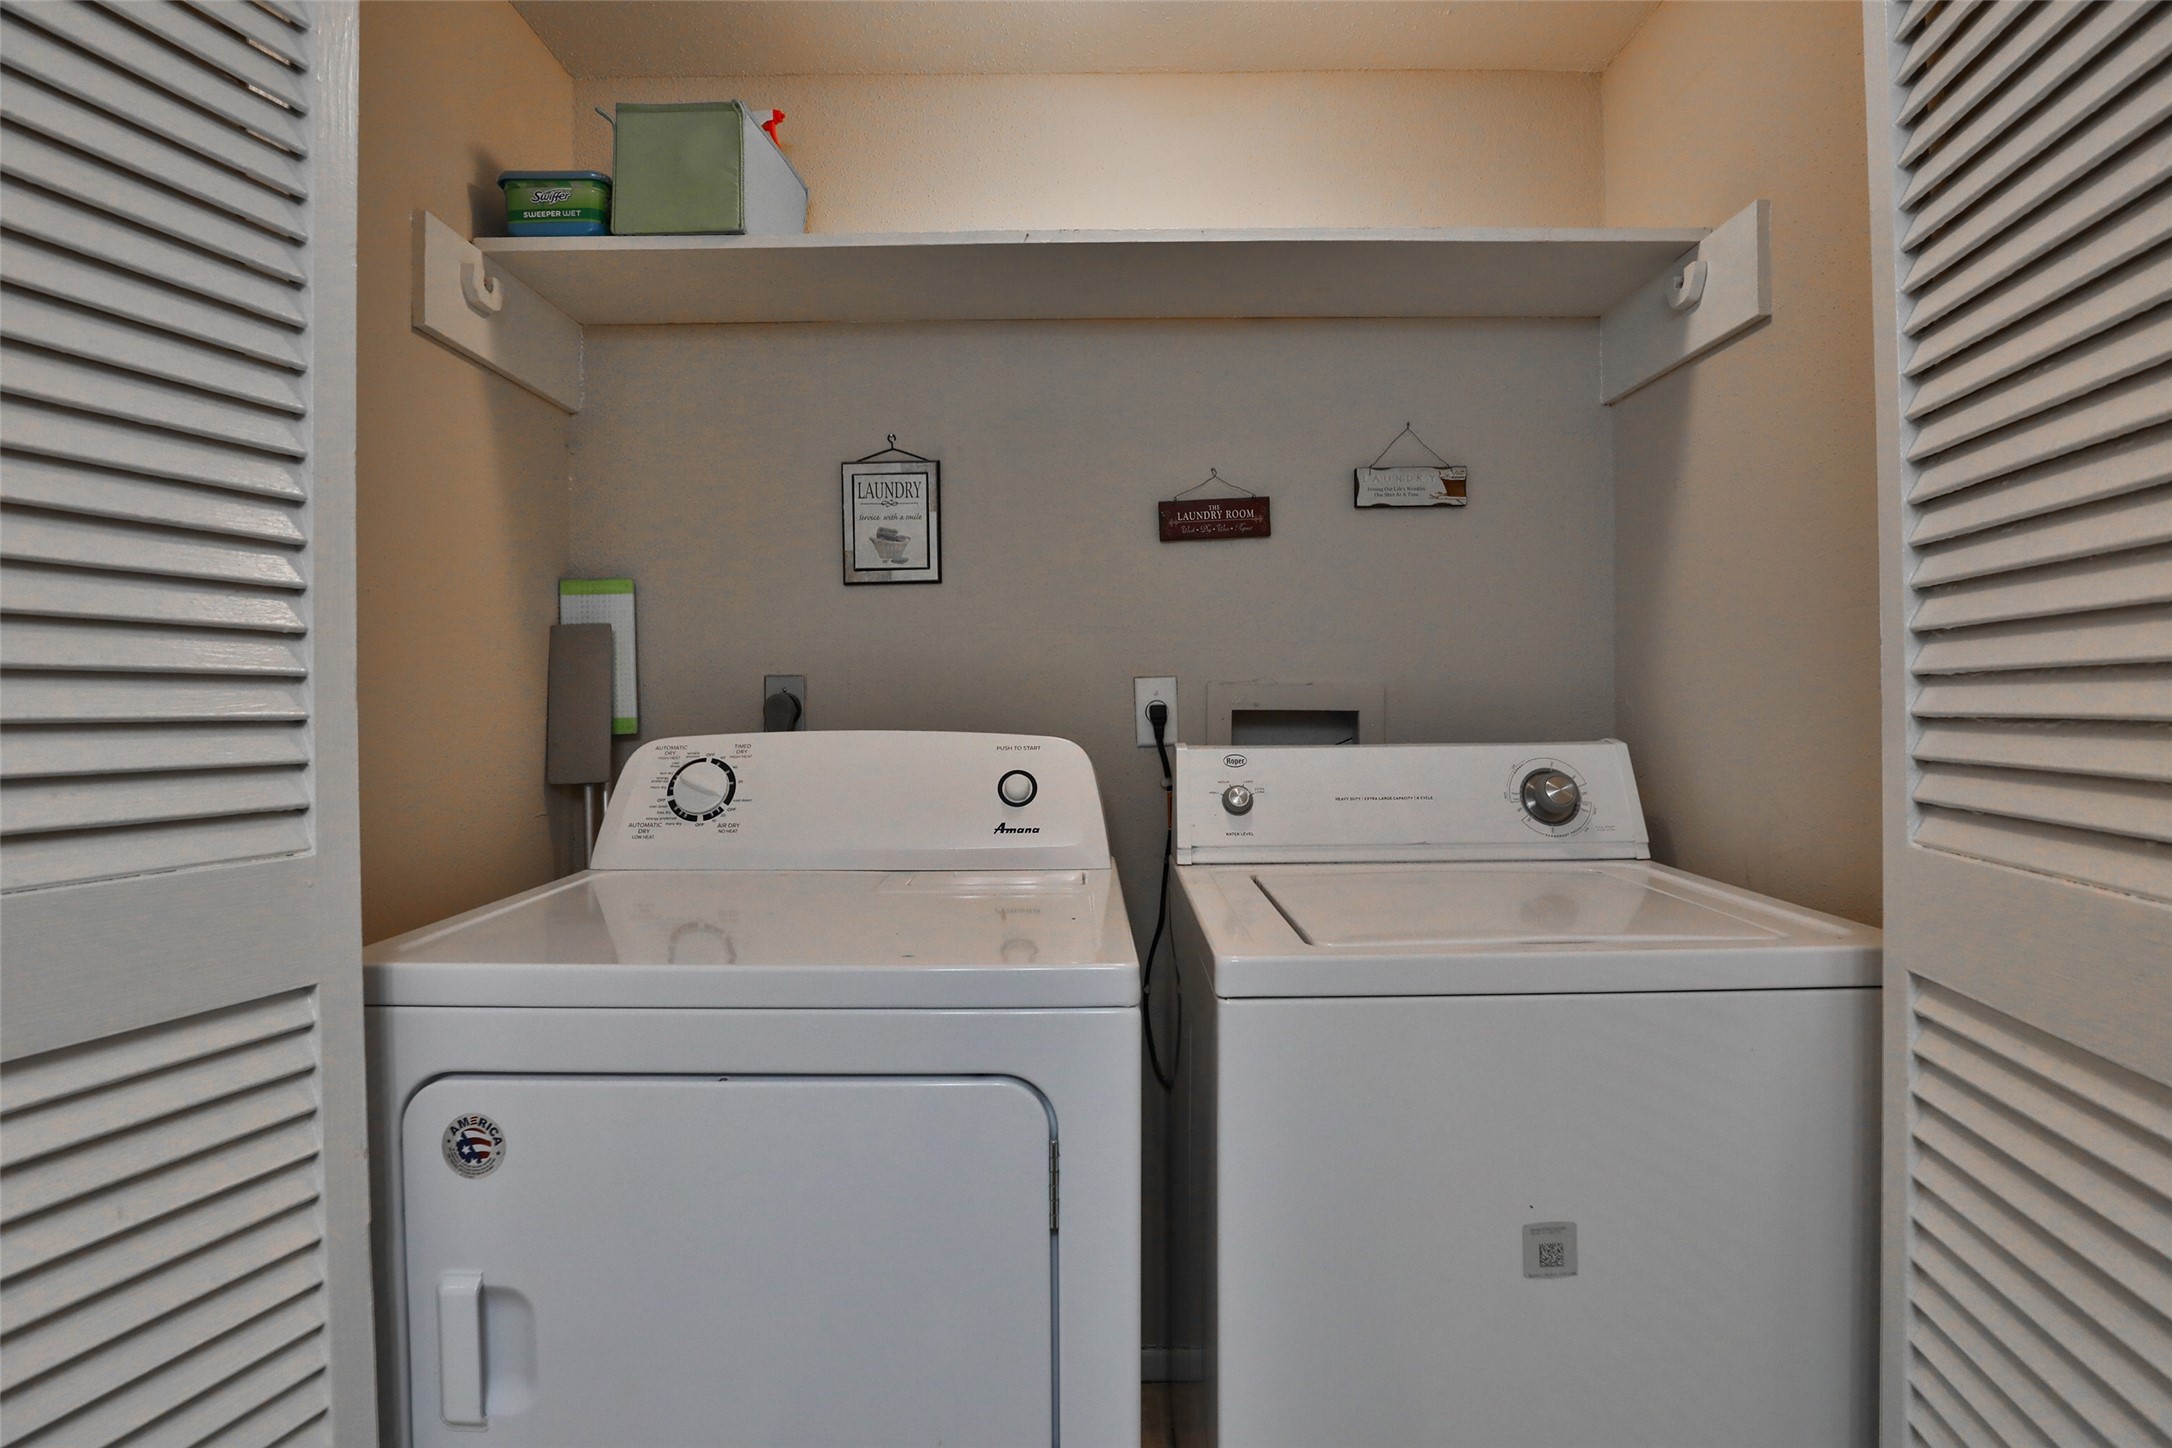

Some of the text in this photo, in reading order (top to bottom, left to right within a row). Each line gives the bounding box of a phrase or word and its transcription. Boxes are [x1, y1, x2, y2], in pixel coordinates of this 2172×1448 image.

[531, 191, 570, 204] Swiffer
[858, 481, 921, 499] LAUNDRY
[906, 512, 922, 520] smile
[1177, 509, 1254, 521] LAUNDRY ROOM
[994, 822, 1040, 834] Amana
[450, 1116, 502, 1146] AMERICA
